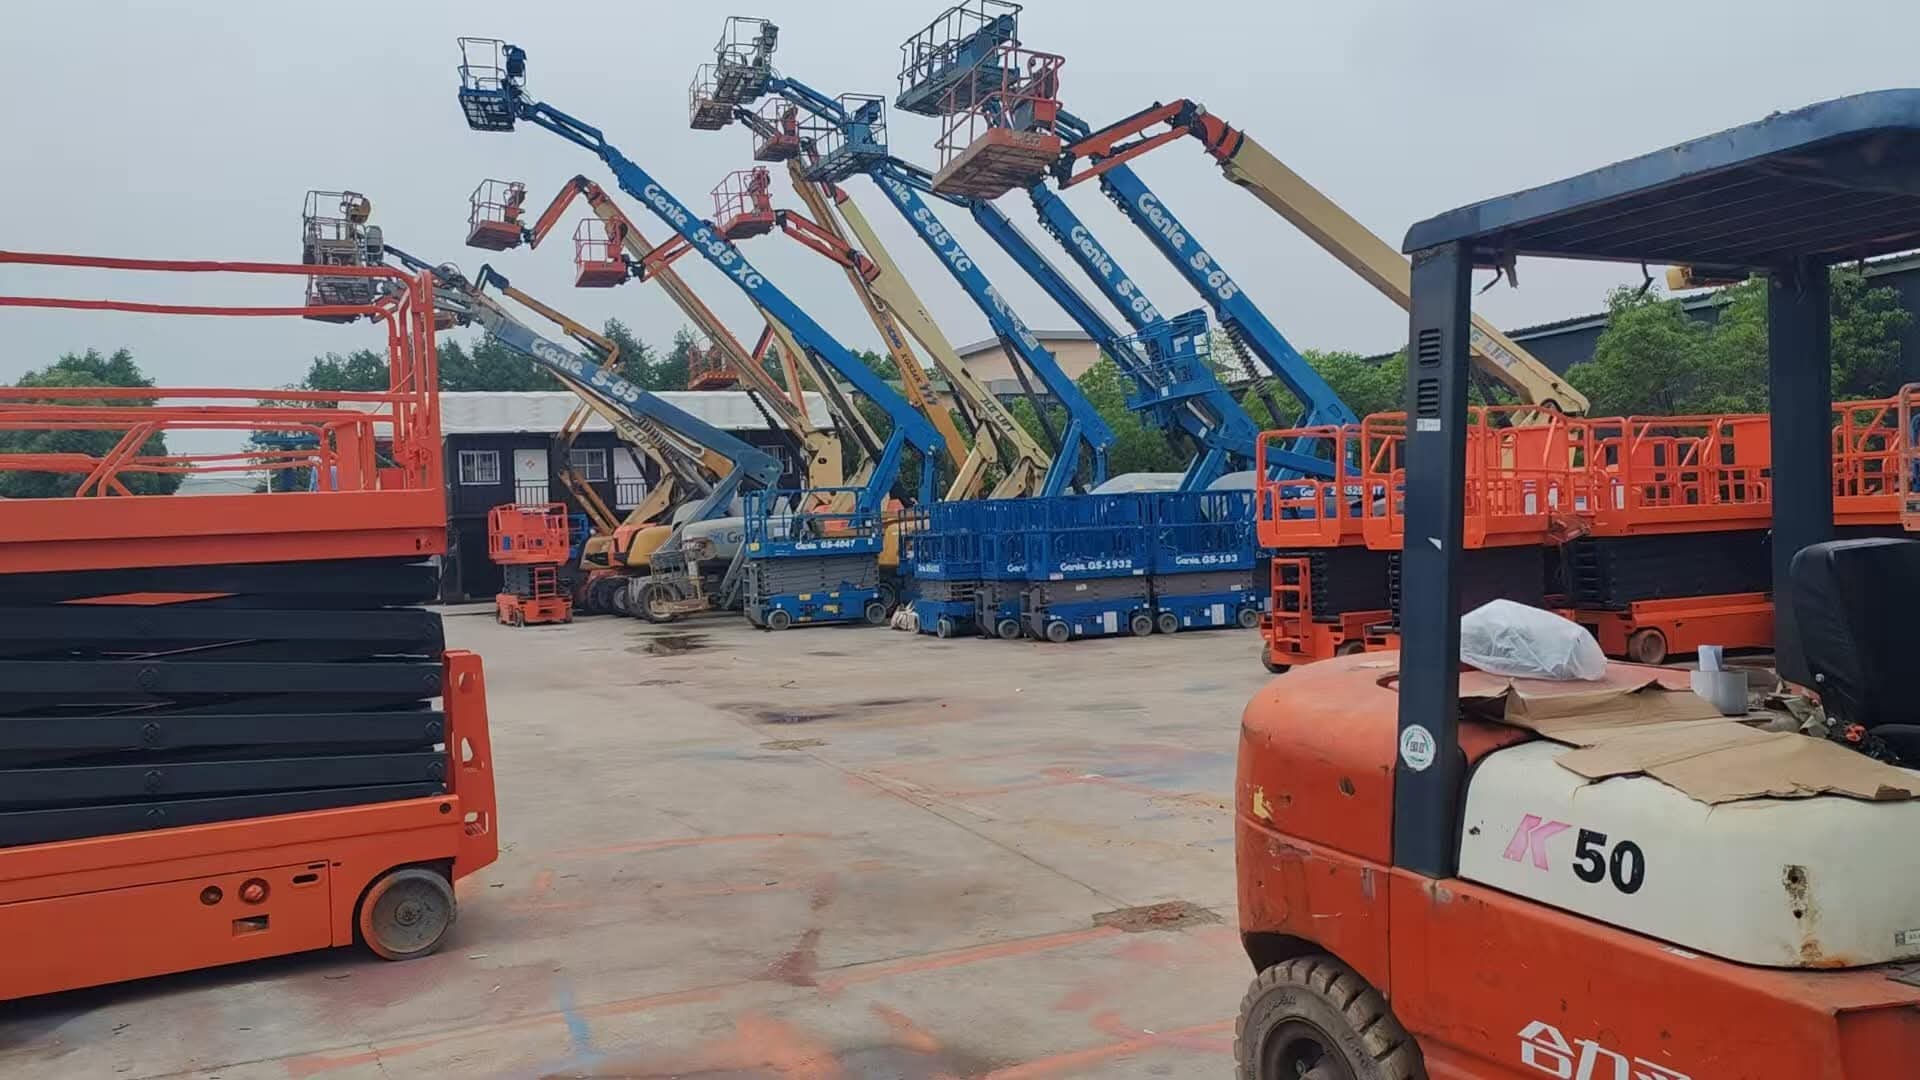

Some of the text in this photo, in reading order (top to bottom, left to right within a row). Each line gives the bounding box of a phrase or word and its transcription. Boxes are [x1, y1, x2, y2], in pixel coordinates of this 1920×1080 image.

[644, 184, 763, 289] Genie S-85 XC
[914, 207, 951, 246] S-85
[945, 246, 972, 272] XC
[1138, 192, 1239, 300] Genie S-65
[1071, 226, 1159, 323] Genie S-65
[531, 338, 640, 402] Genie S-65
[1060, 559, 1133, 571] Genie GS-1932
[1175, 555, 1201, 565] Genie
[1503, 813, 1646, 895] K 50
